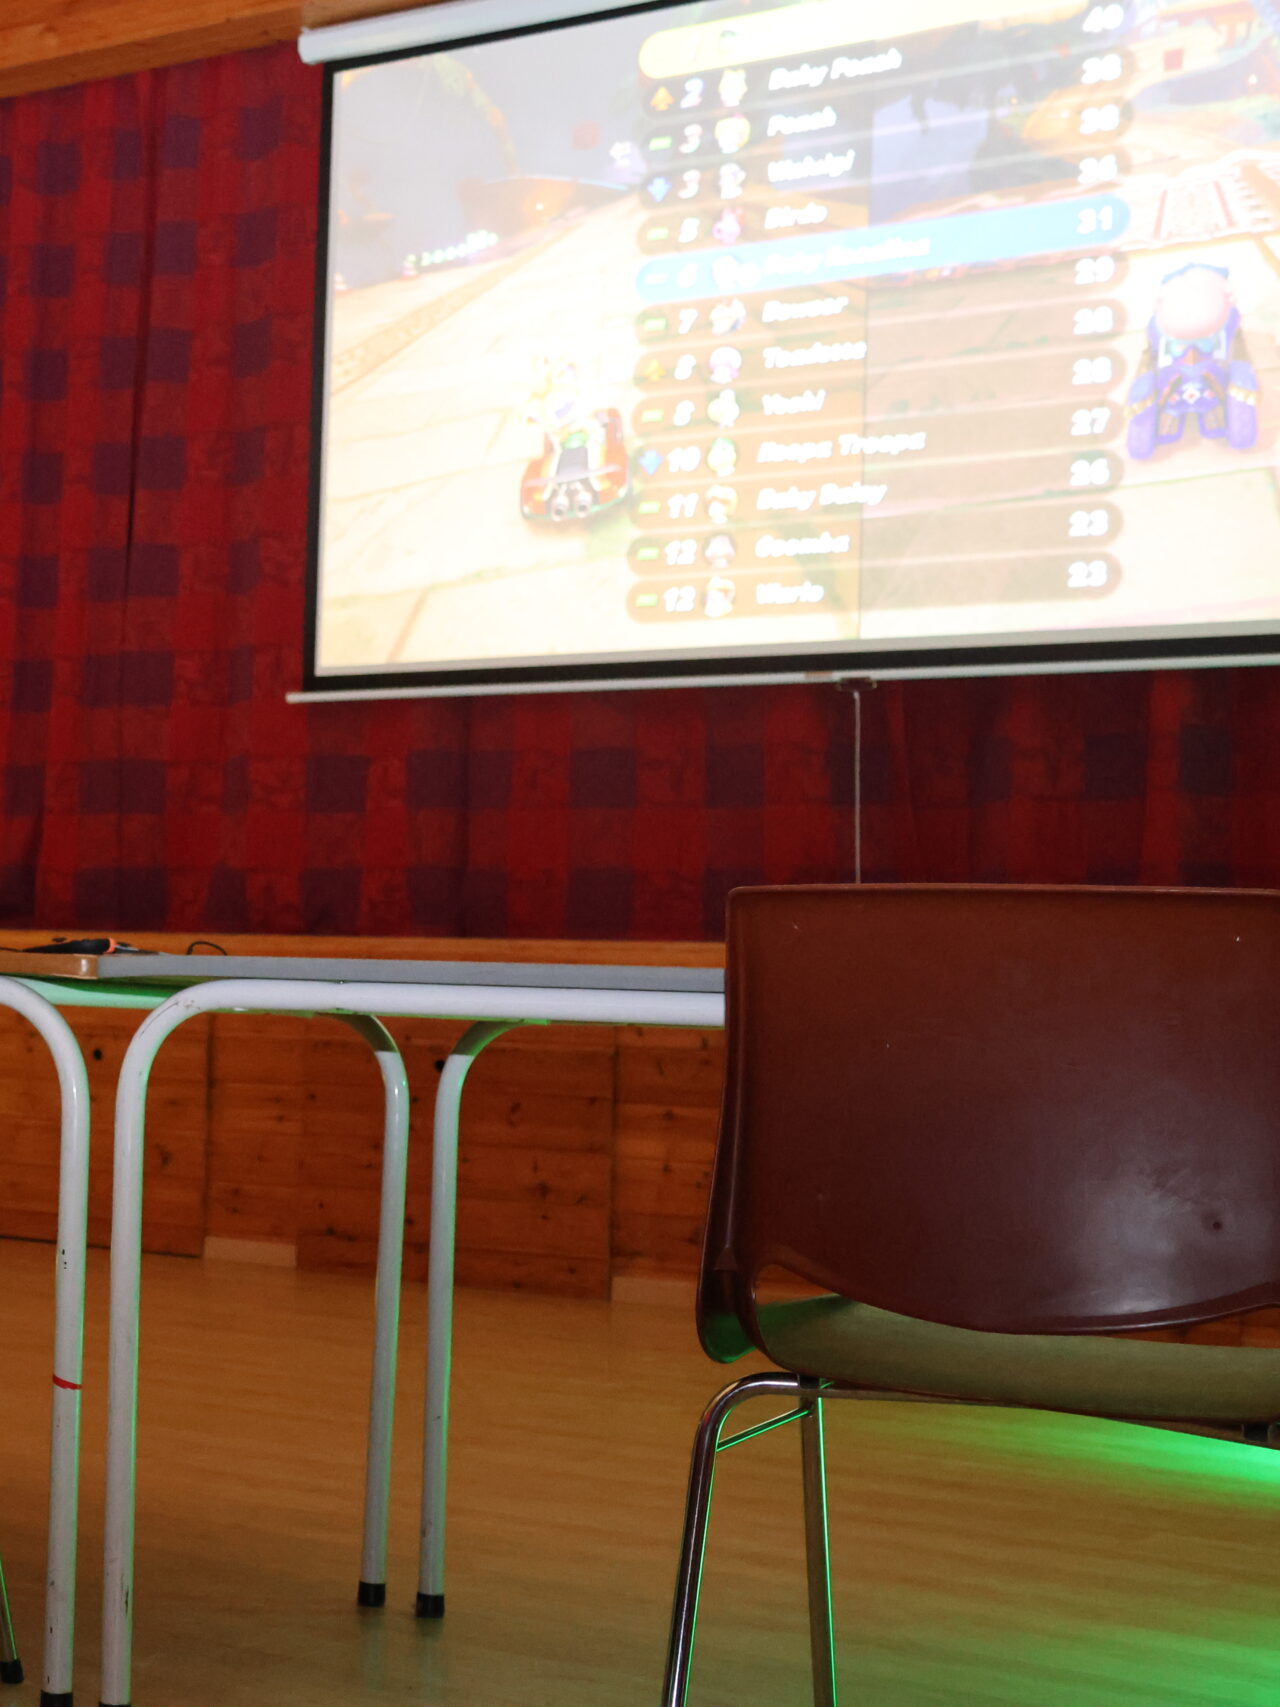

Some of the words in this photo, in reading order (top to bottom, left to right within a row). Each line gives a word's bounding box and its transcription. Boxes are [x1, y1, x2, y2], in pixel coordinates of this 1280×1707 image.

[681, 80, 702, 108] 2
[680, 125, 701, 153] 3
[679, 170, 700, 199] 3
[677, 309, 698, 334] 7
[668, 446, 700, 472] 10
[1071, 408, 1110, 435] 27
[668, 493, 699, 518] 11
[665, 540, 697, 565] 12
[664, 586, 696, 612] 12
